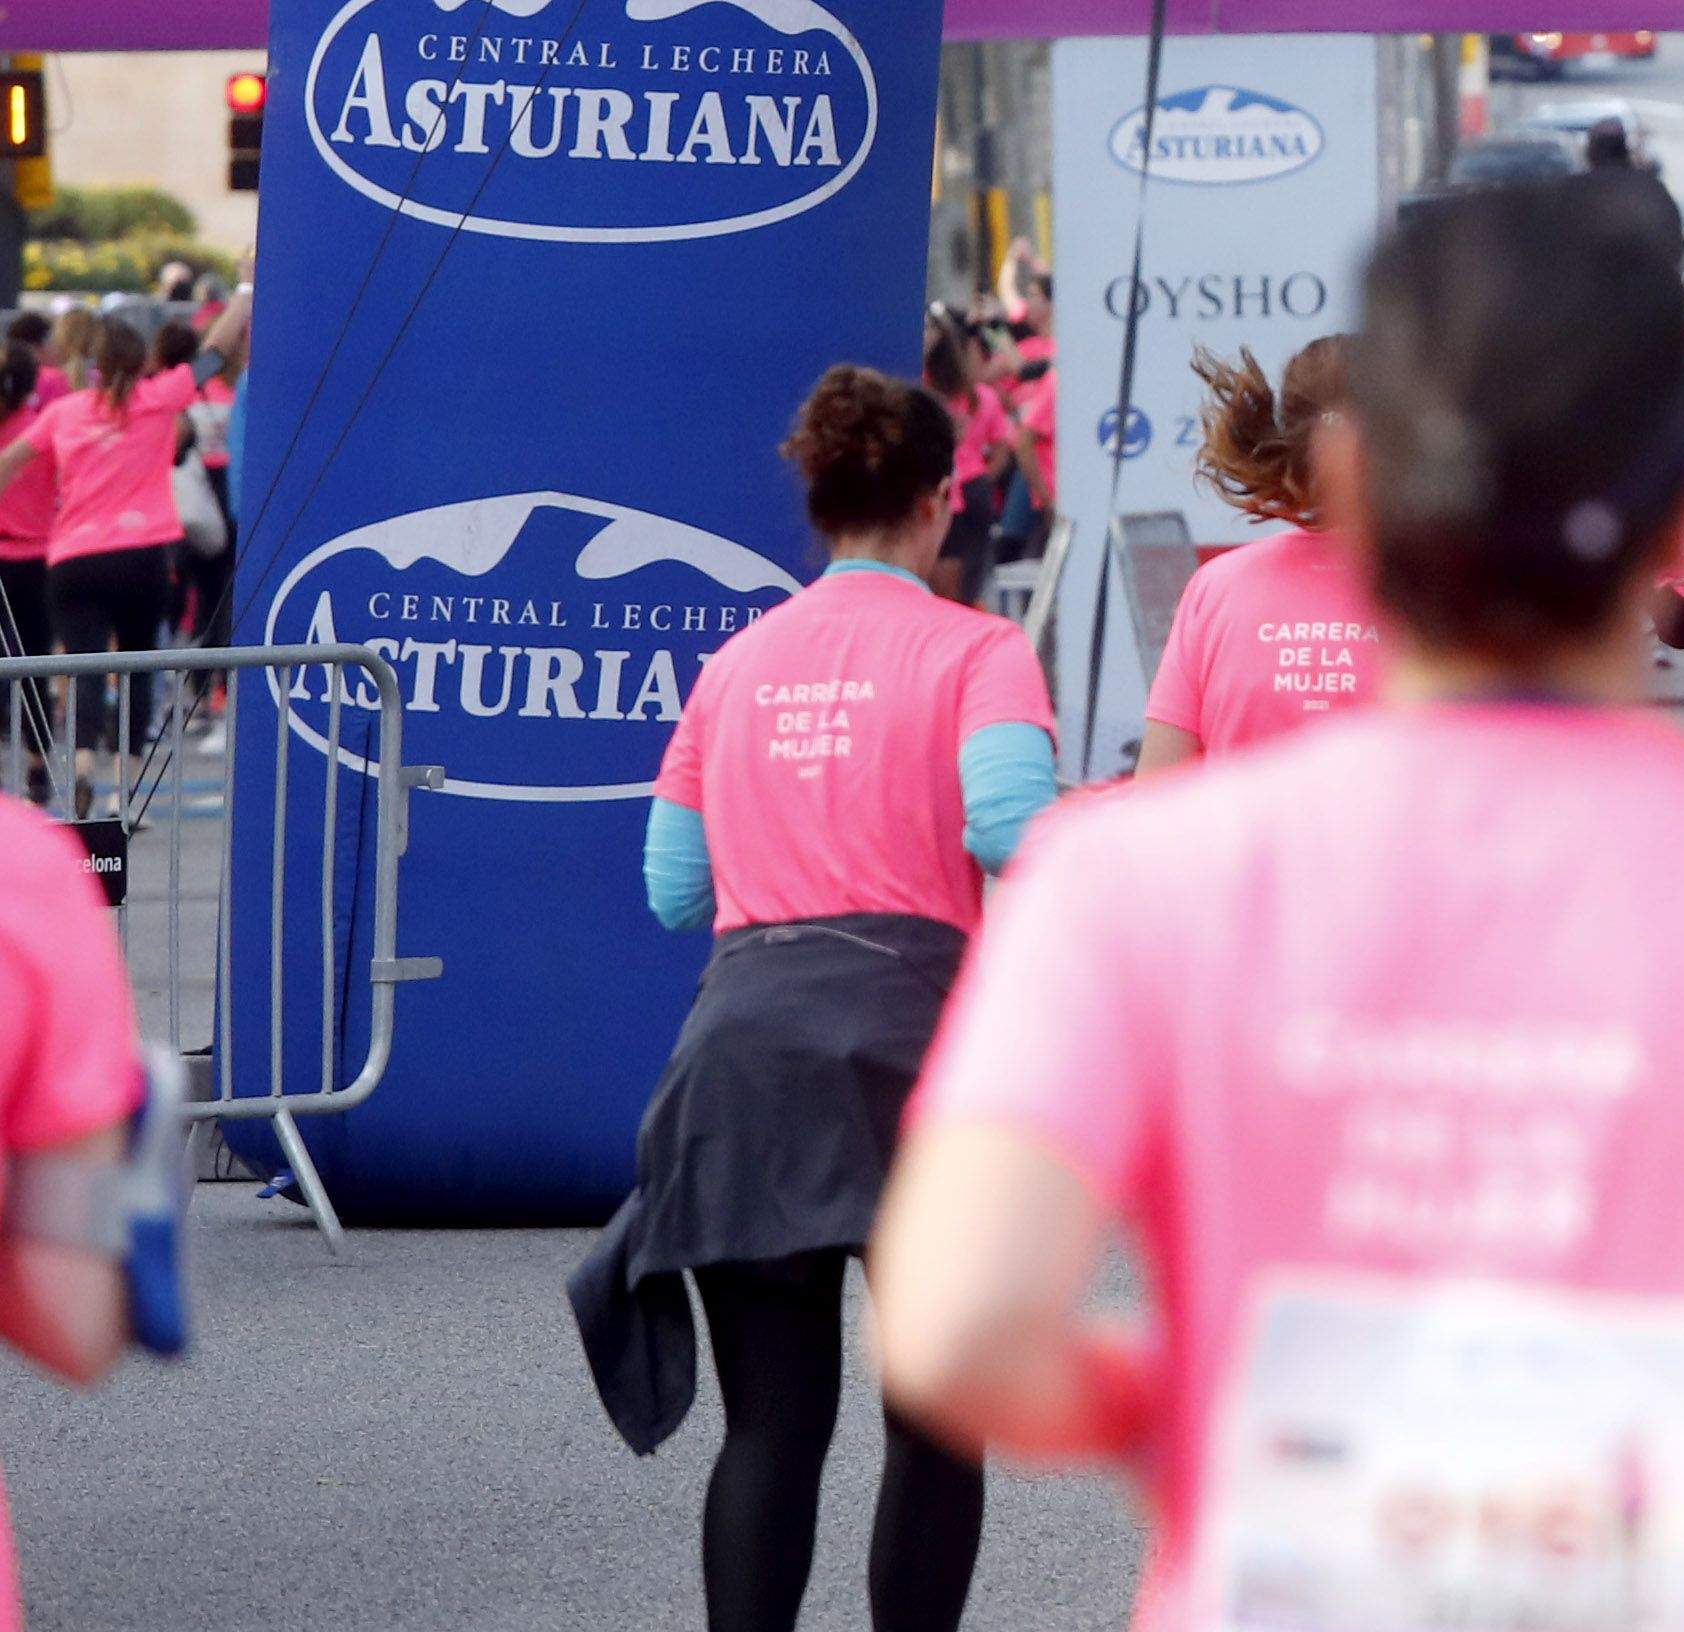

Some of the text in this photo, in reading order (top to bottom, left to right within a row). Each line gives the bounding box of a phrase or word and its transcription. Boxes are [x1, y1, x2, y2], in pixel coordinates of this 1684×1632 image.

[418, 34, 833, 76] CENTRAL LECHERA
[330, 32, 843, 167] ASTURIANA
[1128, 125, 1310, 159] ASTURIANA
[1104, 271, 1328, 321] OYSHO
[368, 591, 765, 634] CENTRAL LECHER
[1258, 622, 1380, 643] CARRERA
[287, 590, 720, 723] ASTURIA
[1279, 646, 1354, 667] DE LA
[755, 680, 876, 706] CARRERA
[1273, 672, 1357, 692] MUJER
[776, 709, 850, 735] DE LA
[768, 734, 853, 760] MUJER
